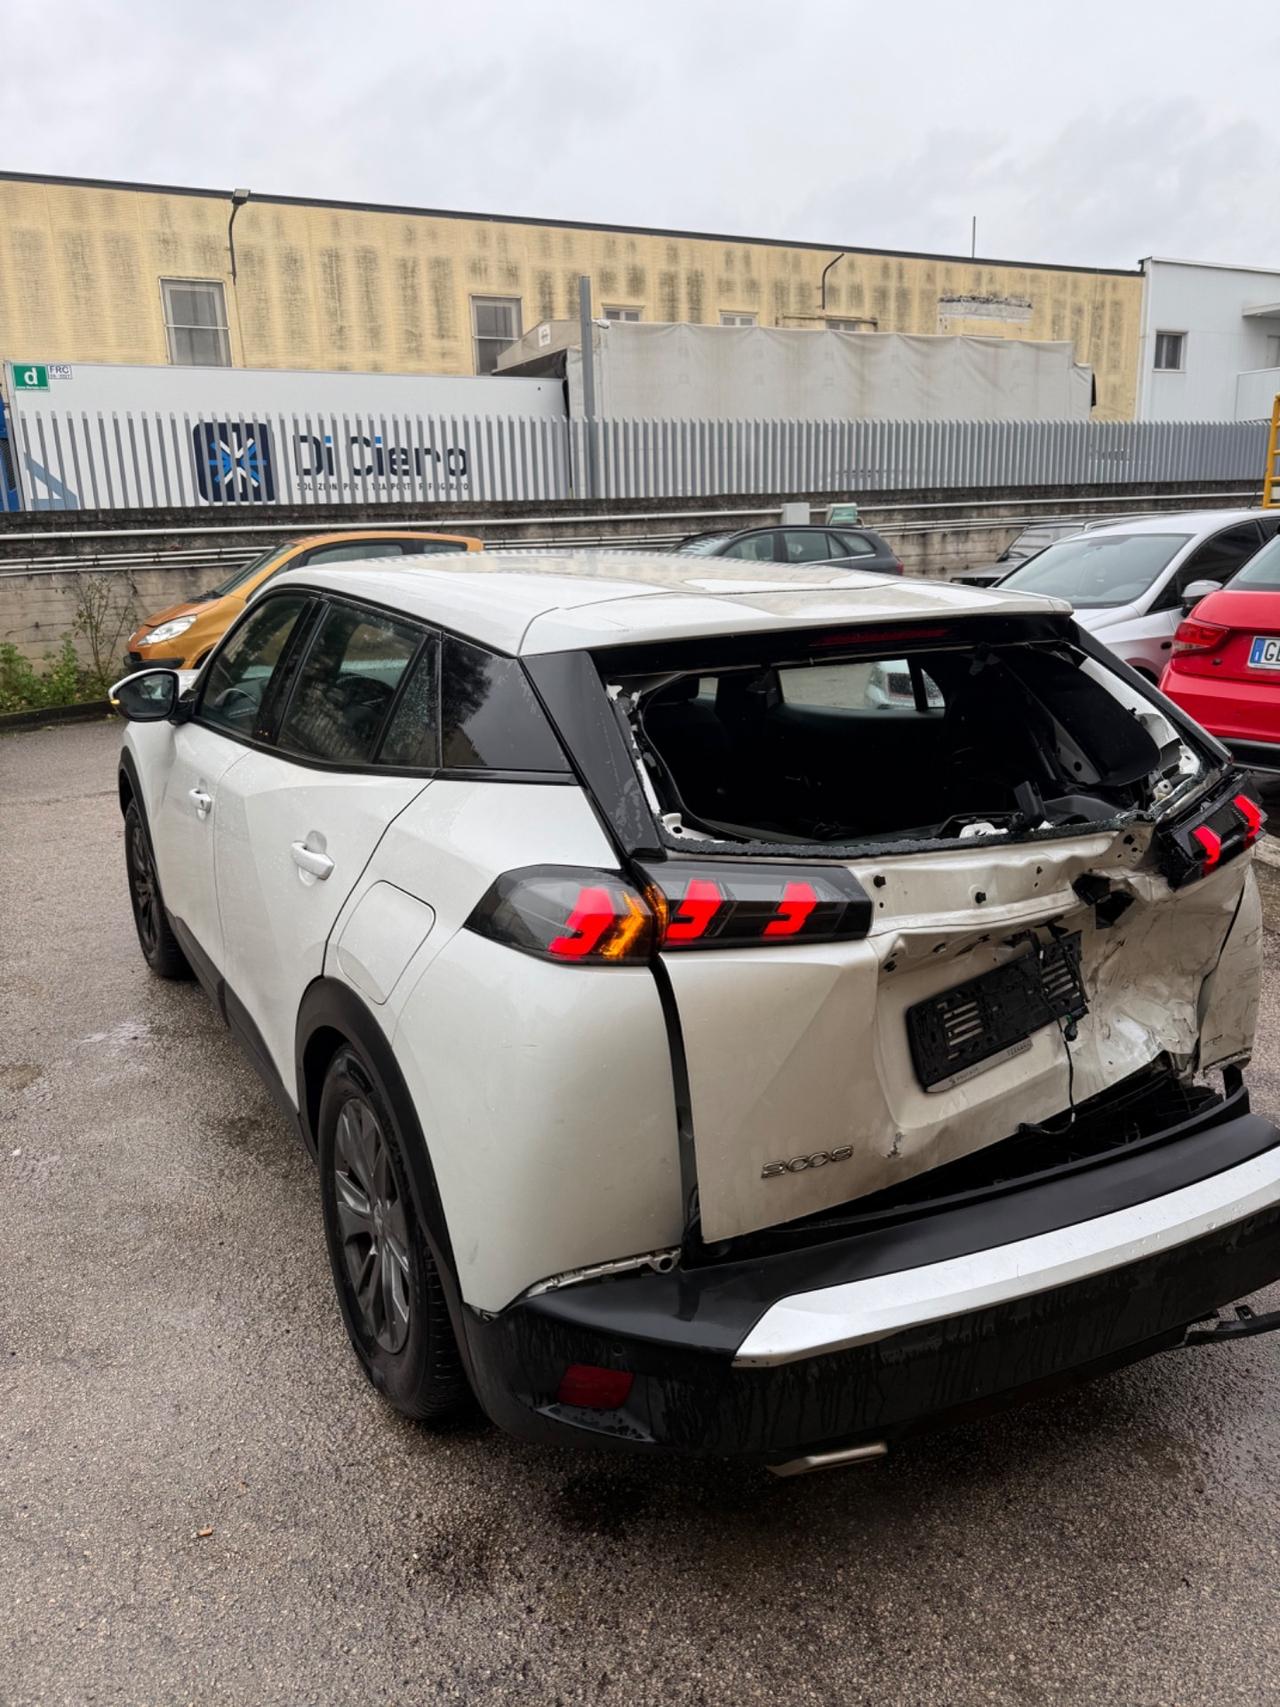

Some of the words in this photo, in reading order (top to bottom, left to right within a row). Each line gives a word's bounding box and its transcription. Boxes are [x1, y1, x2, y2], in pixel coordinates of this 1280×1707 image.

[50, 365, 69, 374] FRC
[293, 435, 334, 476] Di
[761, 1145, 854, 1179] 2008
